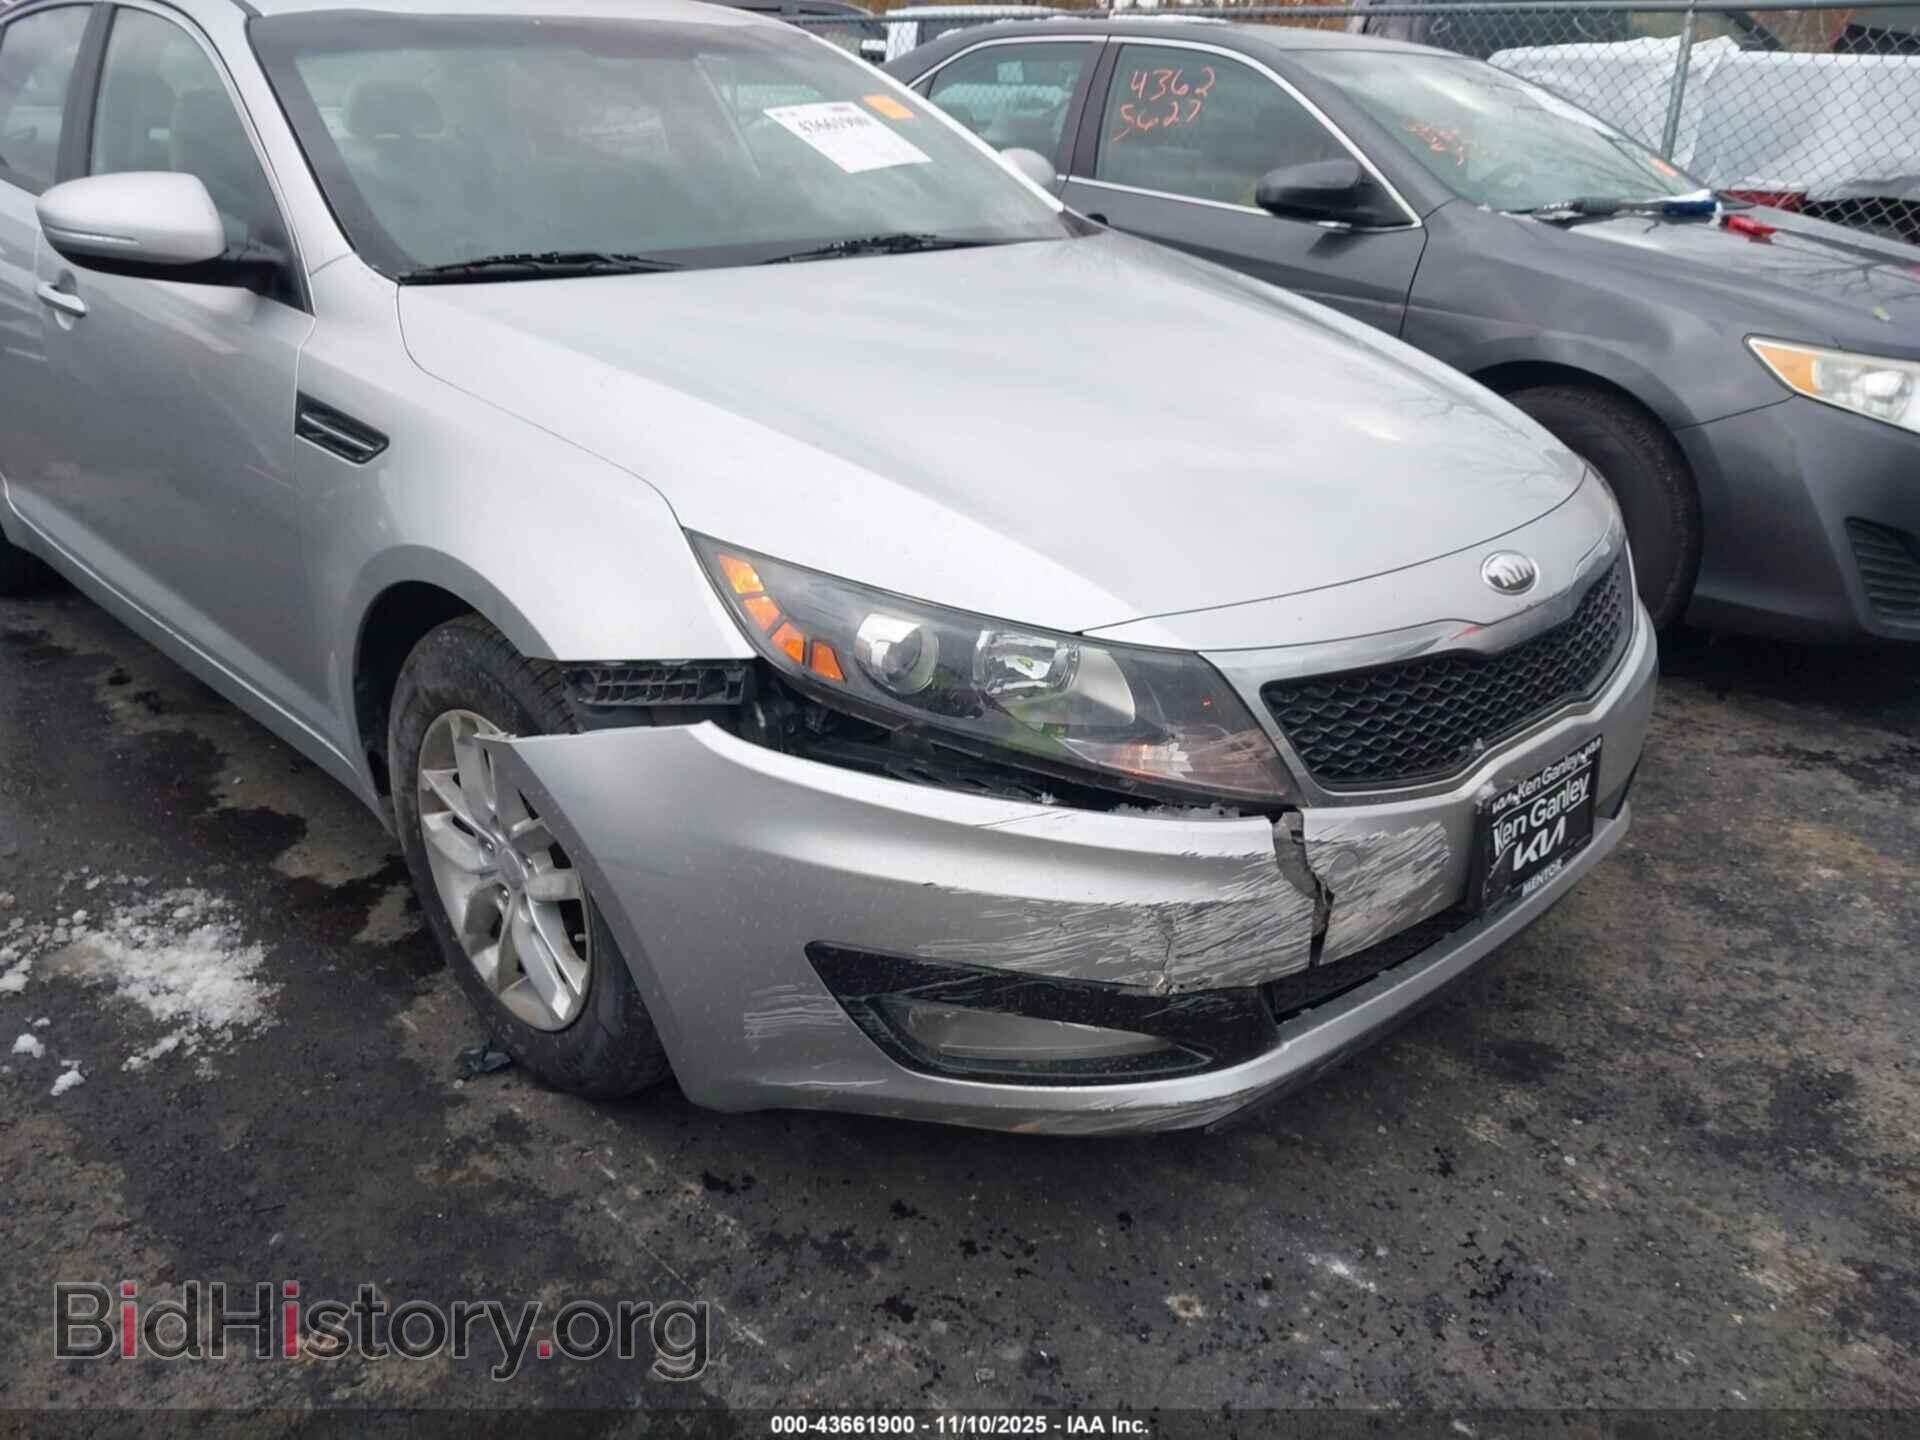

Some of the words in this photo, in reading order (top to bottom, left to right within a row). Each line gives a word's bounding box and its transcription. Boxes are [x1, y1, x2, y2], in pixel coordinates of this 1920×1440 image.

[1130, 66, 1216, 101] 4362
[1517, 776, 1541, 798] Ken
[1541, 754, 1580, 785] Ganley
[1493, 814, 1527, 857] Ken
[1529, 772, 1591, 828] Ganley
